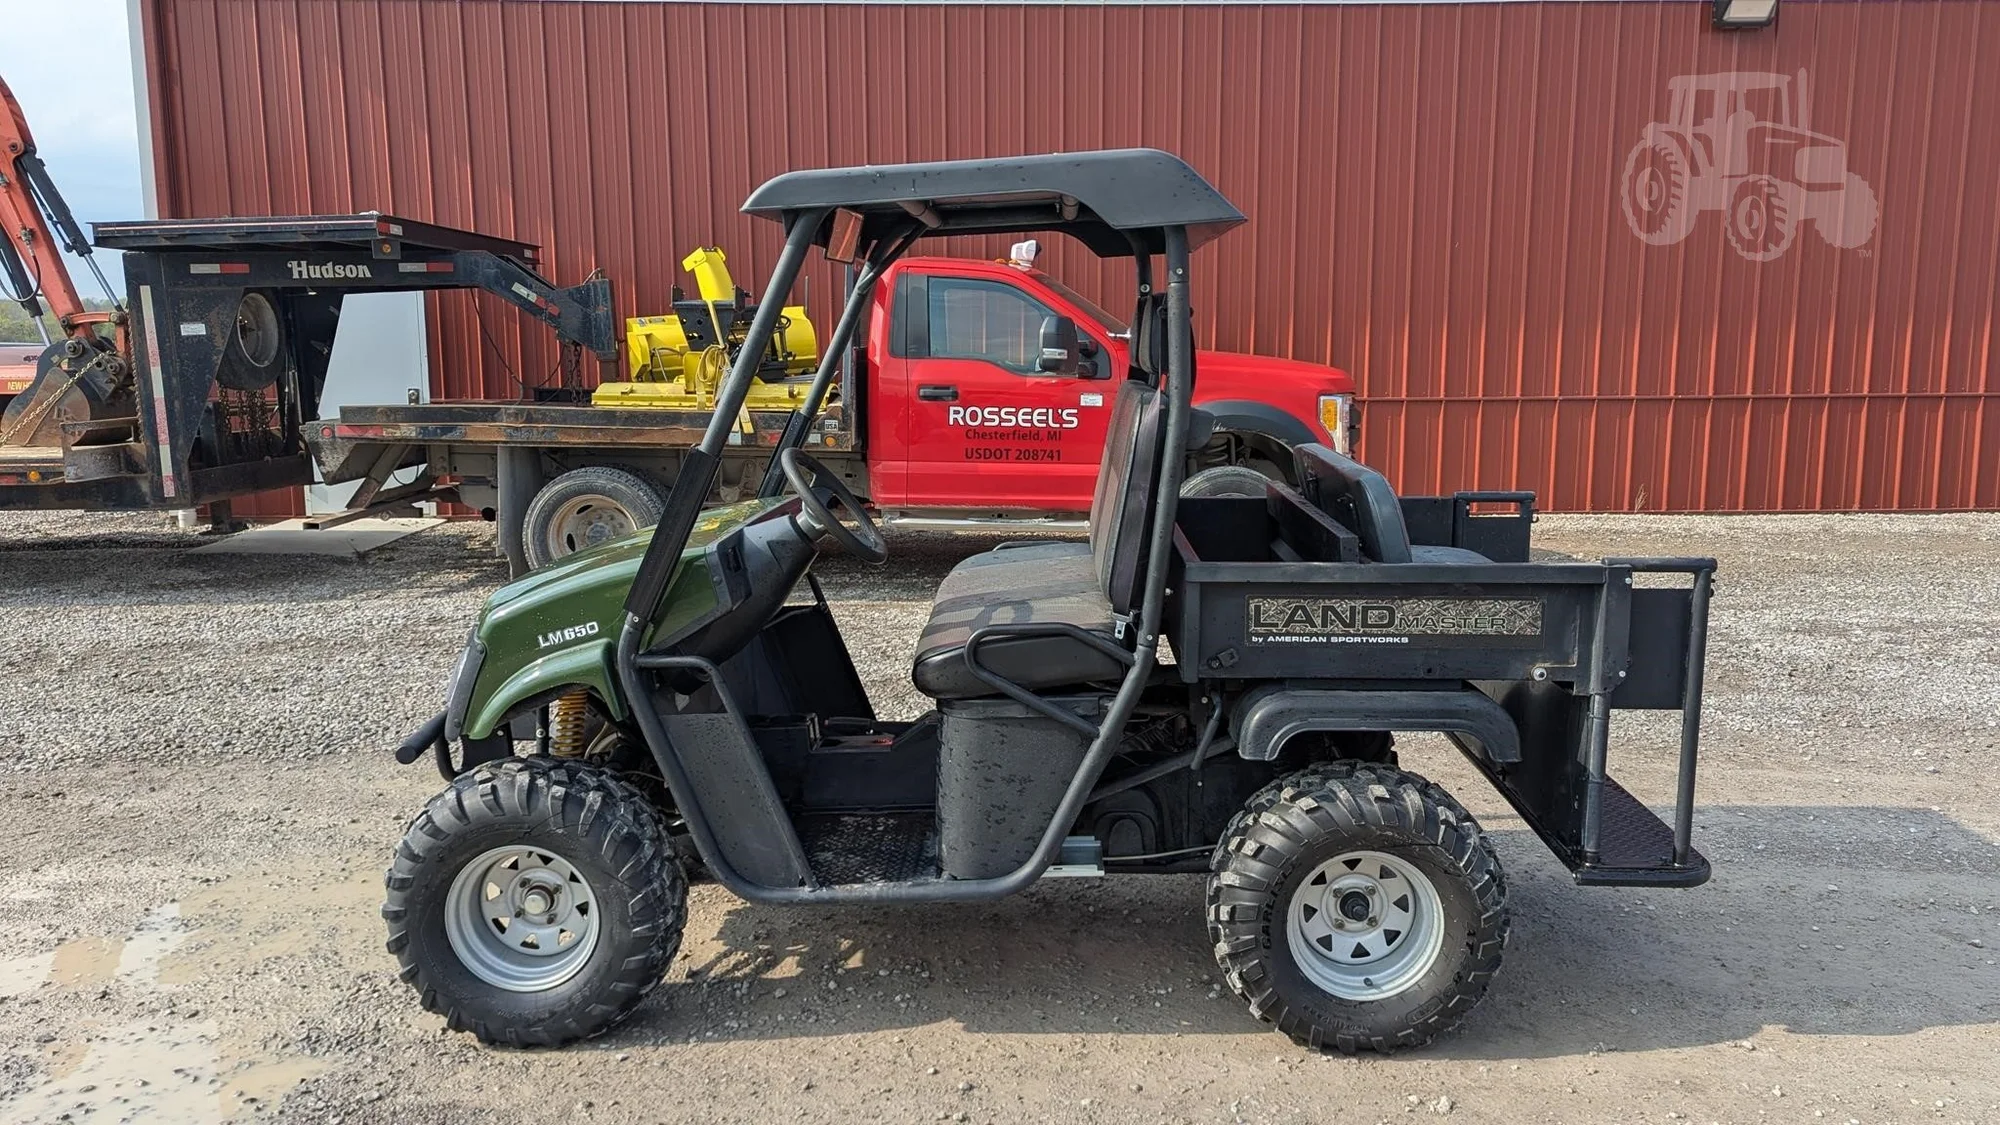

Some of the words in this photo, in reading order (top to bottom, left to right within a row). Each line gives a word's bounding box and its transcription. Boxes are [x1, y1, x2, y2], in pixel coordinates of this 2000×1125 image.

[287, 260, 372, 279] Hudson
[949, 406, 1079, 429] ROSSEEL'S
[965, 429, 1044, 442] Chesterfield,
[1046, 430, 1062, 441] MI
[965, 448, 1011, 460] USDOT
[1014, 449, 1061, 461] 208741
